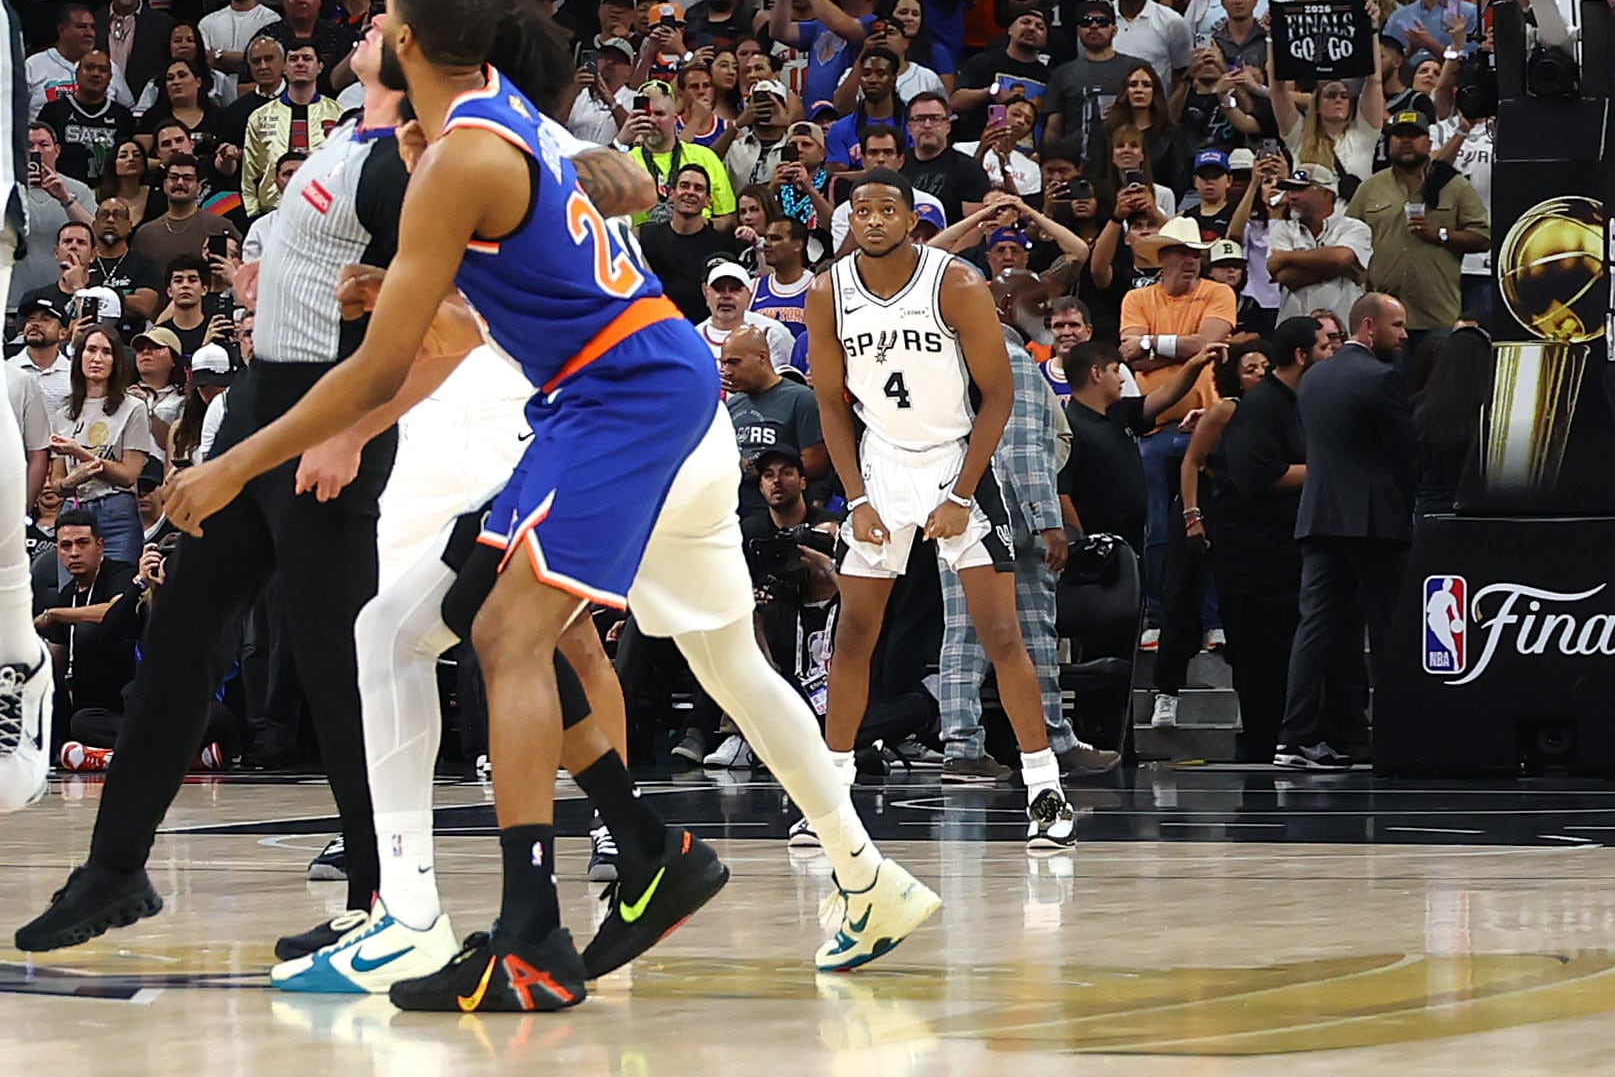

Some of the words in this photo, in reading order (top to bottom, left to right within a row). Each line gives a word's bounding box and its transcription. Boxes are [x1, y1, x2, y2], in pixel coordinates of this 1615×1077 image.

[1051, 4, 1062, 27] 1
[1303, 5, 1332, 14] 2026
[1284, 11, 1356, 41] FINALS
[1289, 37, 1315, 62] GO
[1327, 36, 1354, 62] GO
[843, 330, 943, 365] SPURS
[882, 371, 913, 409] 4
[1428, 650, 1451, 668] NBA
